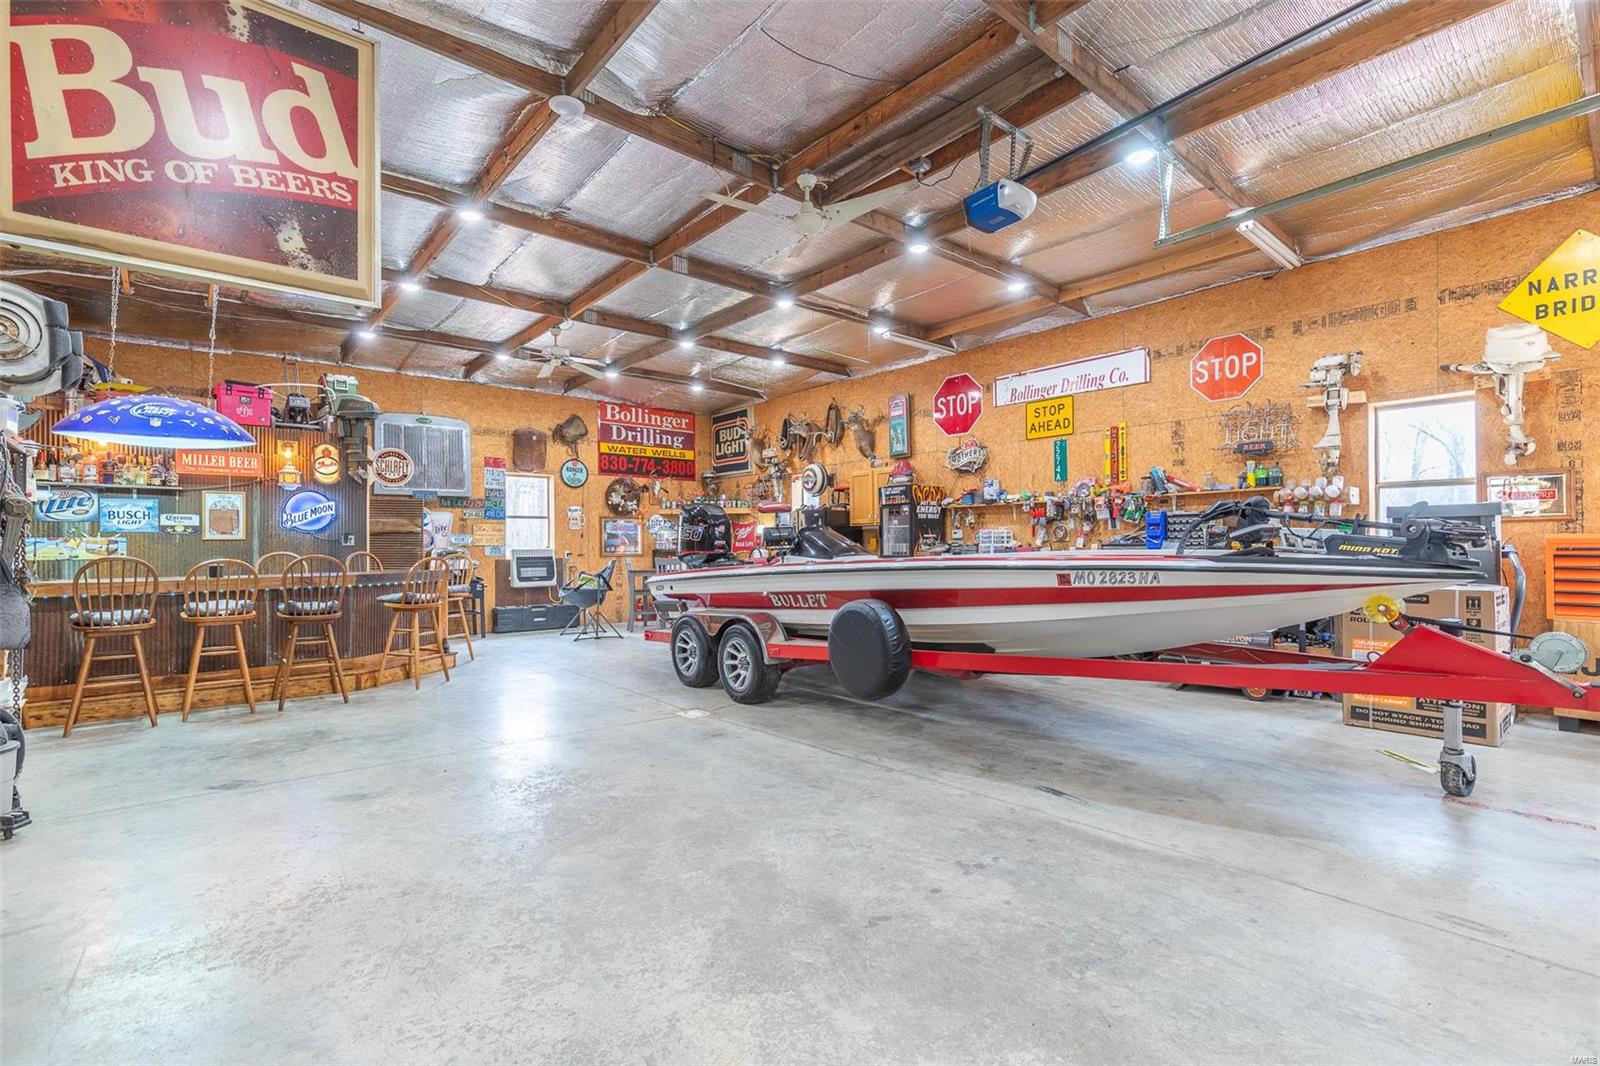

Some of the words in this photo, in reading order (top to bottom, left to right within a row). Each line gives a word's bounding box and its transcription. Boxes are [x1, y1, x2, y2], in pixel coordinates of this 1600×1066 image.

[10, 23, 359, 181] Bud
[50, 159, 154, 188] KING
[165, 160, 218, 185] OF
[229, 164, 352, 202] BEERS
[1528, 268, 1597, 296] NARR
[1535, 295, 1596, 320] BRID
[1194, 352, 1257, 384] STOP
[1010, 385, 1058, 403] Bollinger
[1060, 373, 1106, 393] Drilling
[1109, 367, 1129, 384] Co.
[937, 391, 979, 419] STOP
[1033, 403, 1066, 418] STOP
[604, 403, 689, 429] Bollinger
[1029, 417, 1071, 434] AHEAD
[609, 424, 685, 448] Drilling
[720, 427, 741, 442] BUD
[607, 445, 647, 455] WATER
[651, 449, 686, 458] WELLS
[716, 440, 745, 456] LIGHT
[1243, 443, 1266, 451] BEER
[182, 453, 225, 467] MILLER
[229, 456, 257, 468] BEER
[375, 459, 410, 475] SCHLAFLY
[601, 455, 693, 475] 830-774-3800
[107, 510, 151, 520] BUSCH
[283, 510, 309, 527] BLUE
[310, 503, 334, 518] MOON
[917, 505, 941, 513] ENERGY
[1073, 571, 1096, 585] MO
[1099, 571, 1137, 585] 2823
[1139, 571, 1161, 584] HA
[769, 593, 828, 608] BULLET
[1391, 713, 1422, 721] STACK
